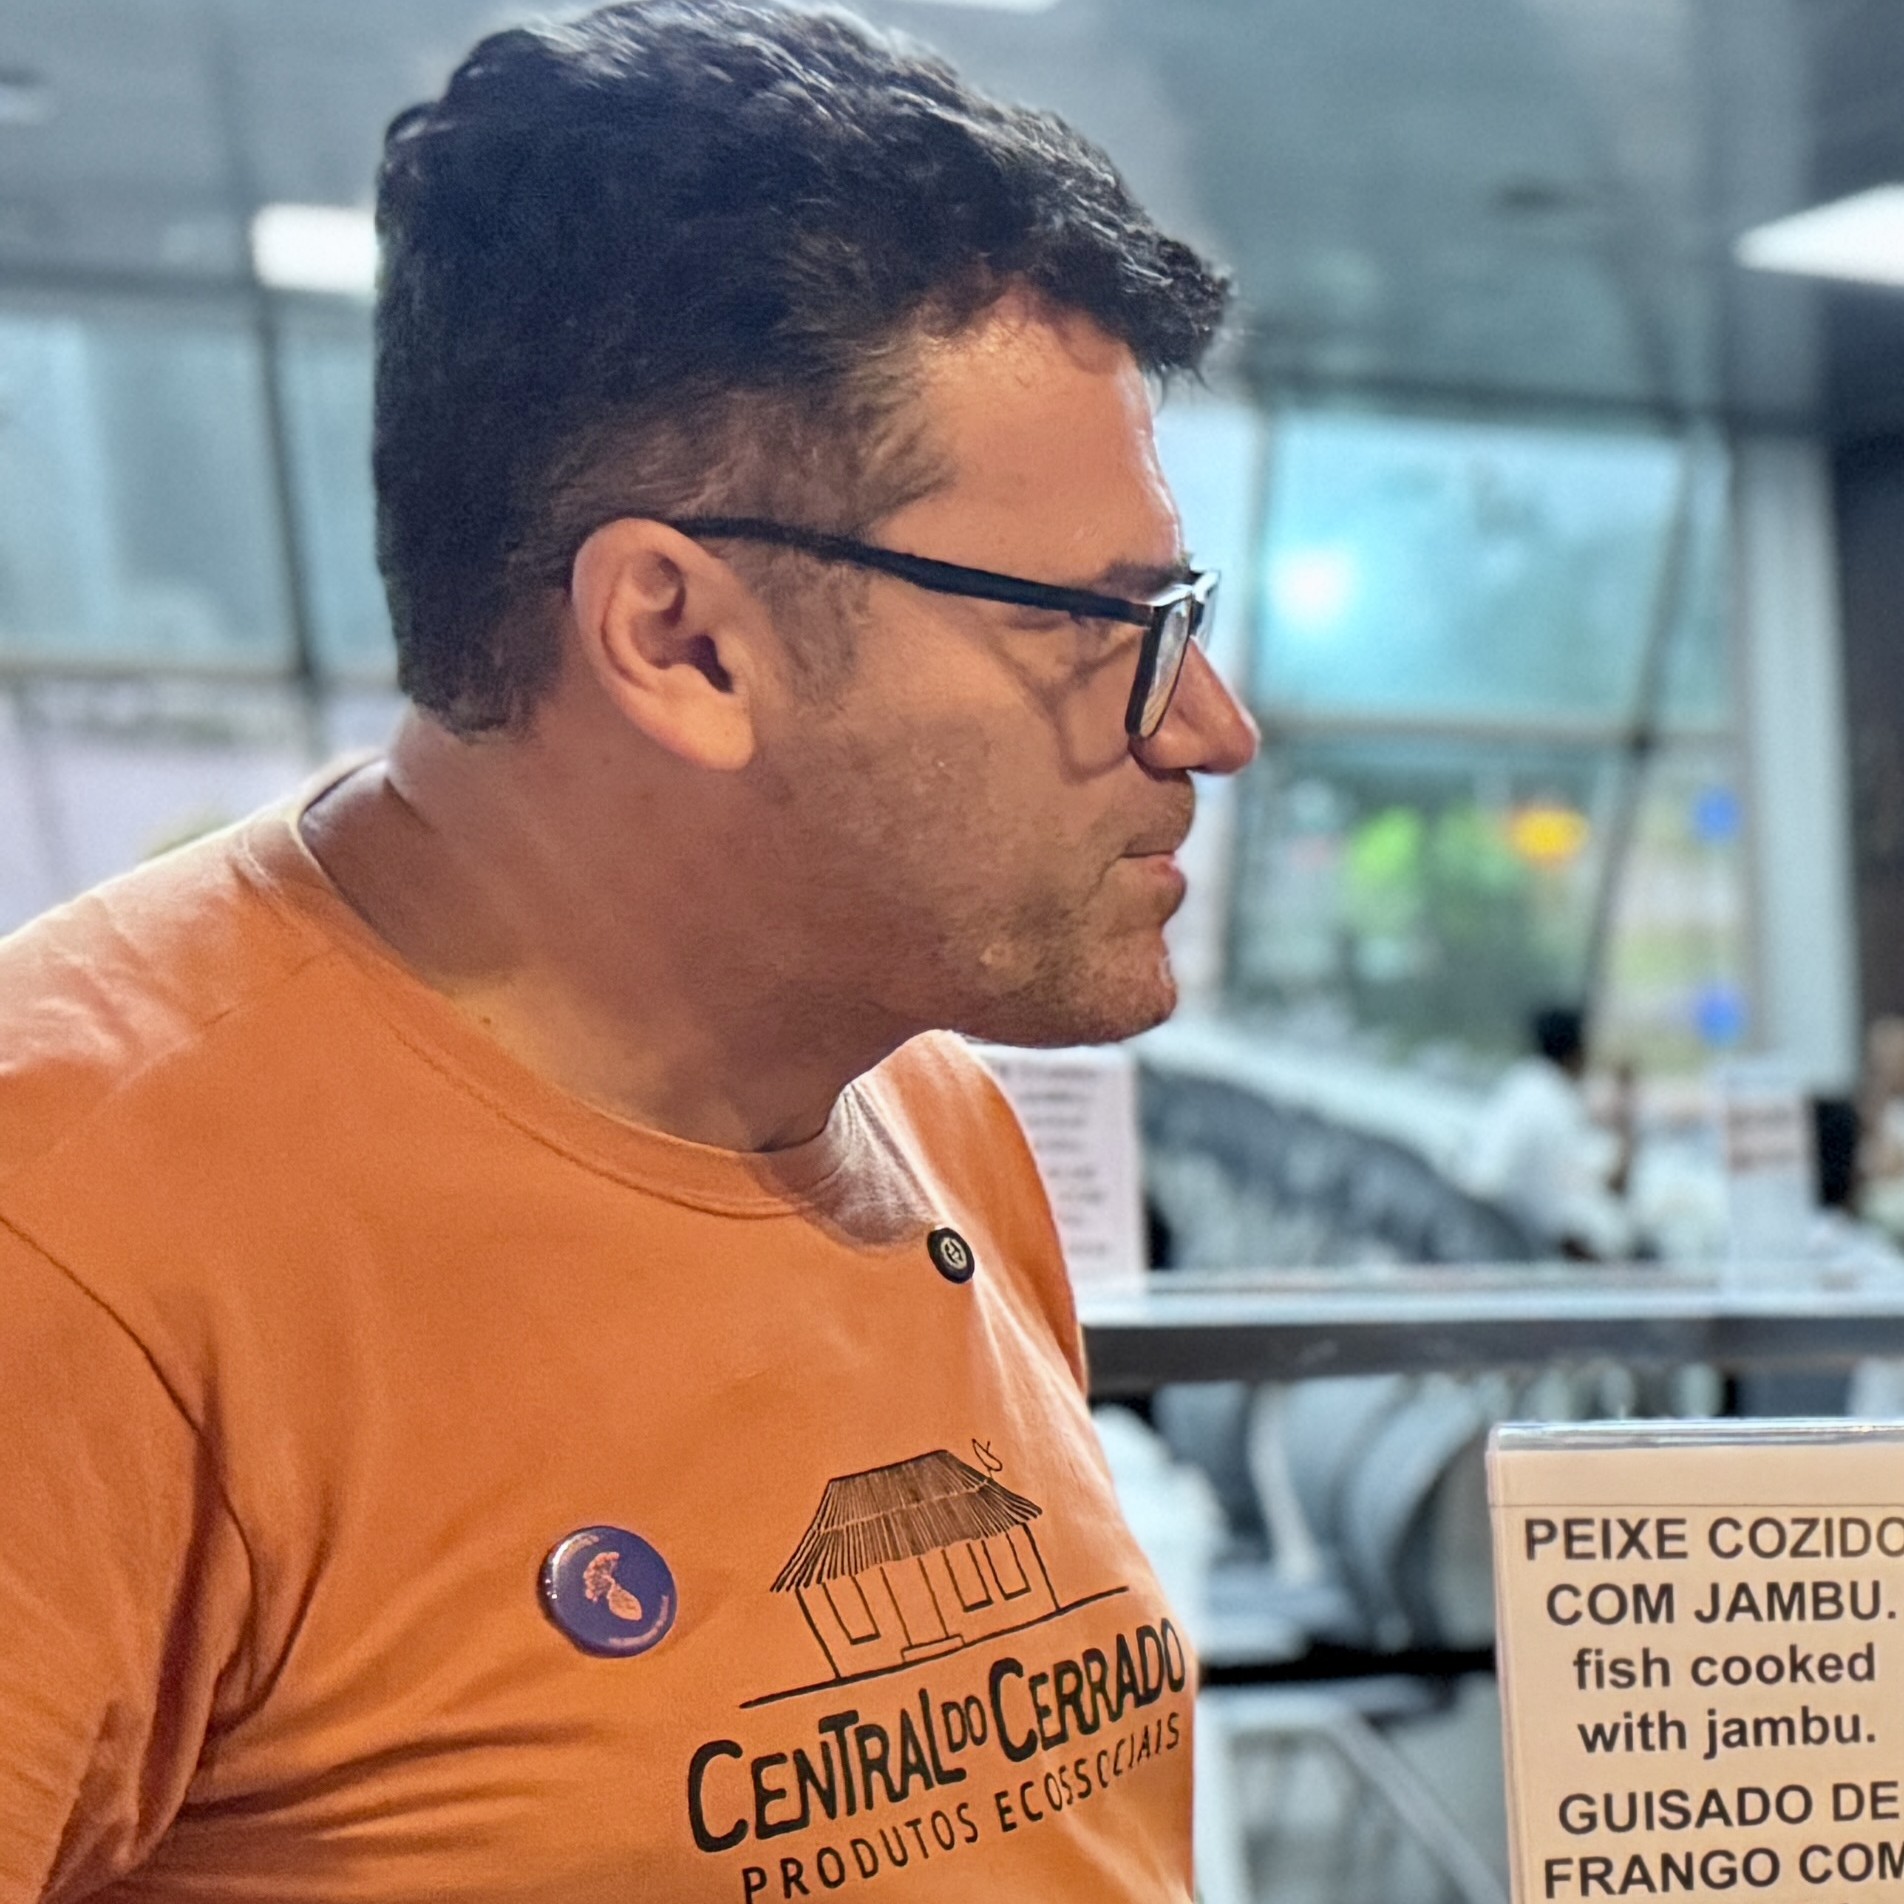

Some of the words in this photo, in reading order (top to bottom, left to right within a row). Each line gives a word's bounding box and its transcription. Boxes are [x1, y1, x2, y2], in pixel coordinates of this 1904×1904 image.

[1525, 1518, 1688, 1560] PEIXE
[1547, 1583, 1674, 1626] COM
[1694, 1580, 1895, 1623] JAMBU.
[1573, 1647, 1670, 1690] fish
[1691, 1642, 1874, 1686] cooked
[1578, 1710, 1686, 1753] with
[1703, 1705, 1875, 1760] jambu.
[1559, 1784, 1812, 1835] GUISADO
[1832, 1781, 1899, 1821] DE
[1545, 1848, 1780, 1898] FRANGO
